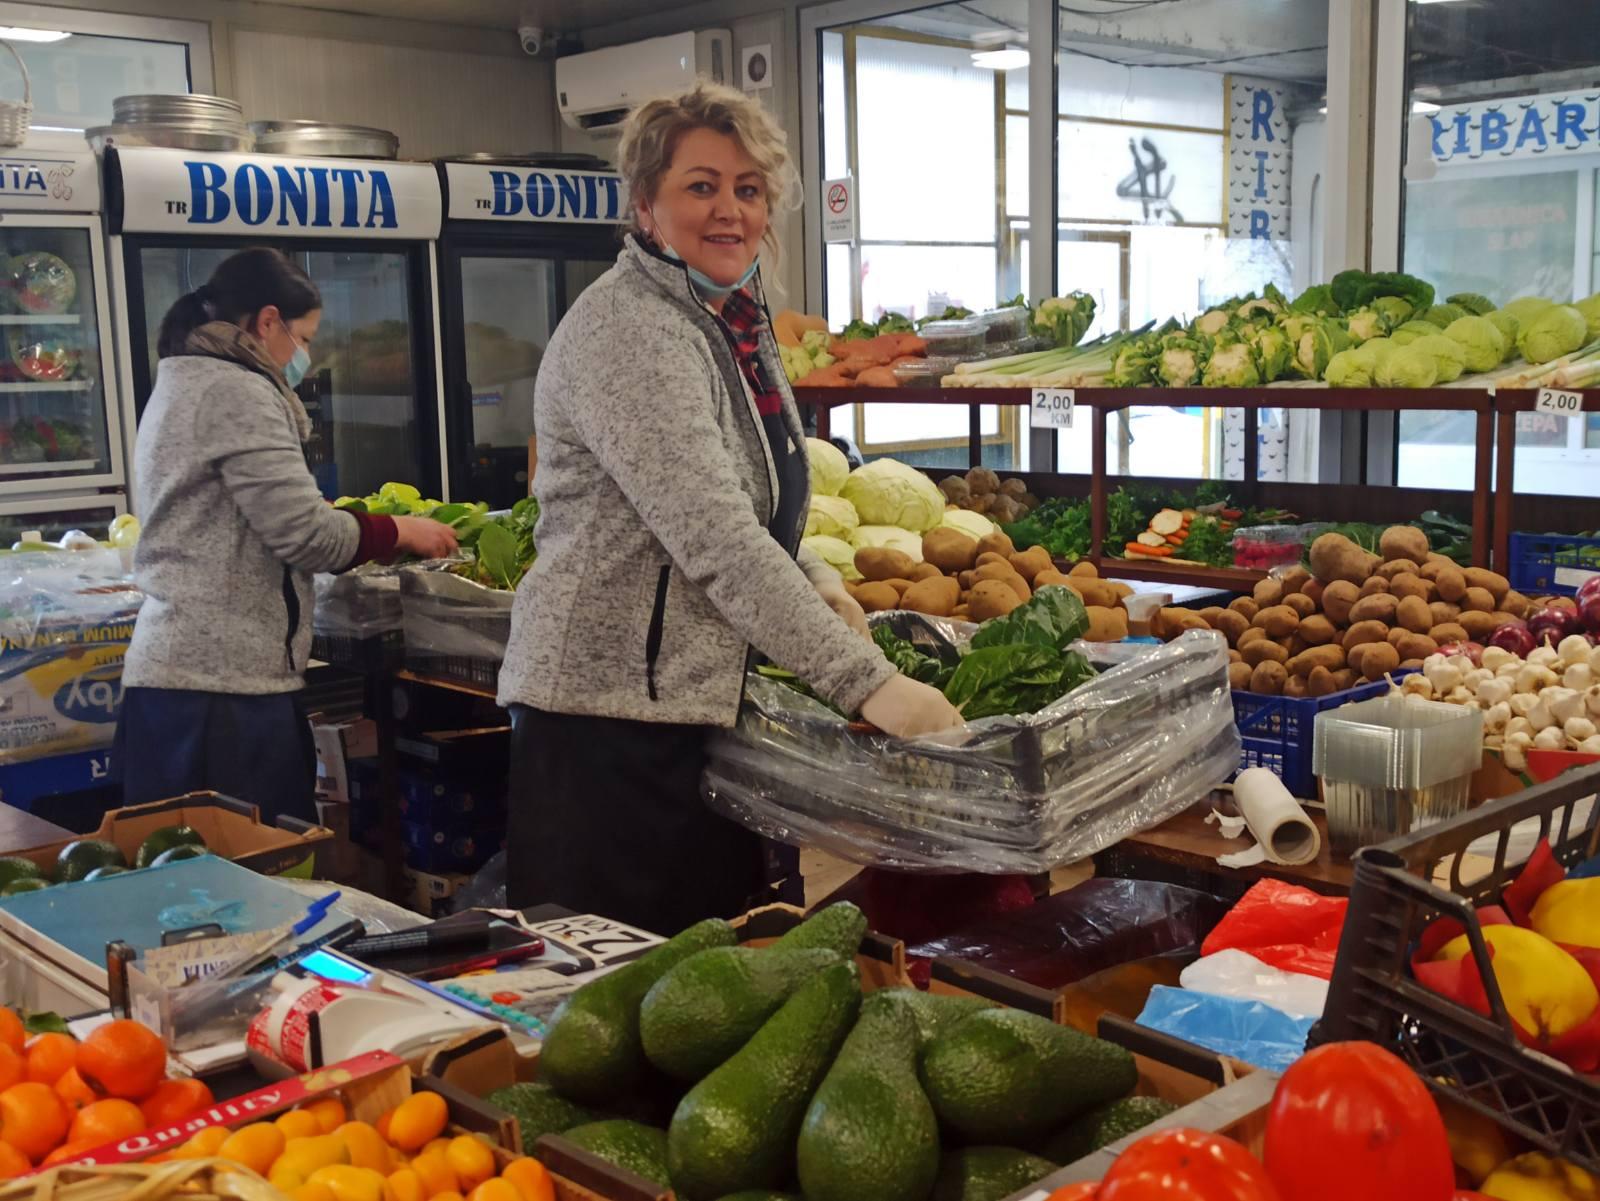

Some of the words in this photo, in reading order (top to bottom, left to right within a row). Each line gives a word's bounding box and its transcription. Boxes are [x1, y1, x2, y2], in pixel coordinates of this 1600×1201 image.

[165, 200, 187, 214] TR
[184, 161, 398, 228] BONITA
[474, 198, 491, 209] TR
[489, 171, 631, 219] BONIT
[1036, 392, 1071, 412] 2,00
[1542, 392, 1577, 410] 2,00
[1051, 413, 1071, 425] KM
[118, 1090, 281, 1153] Quality
